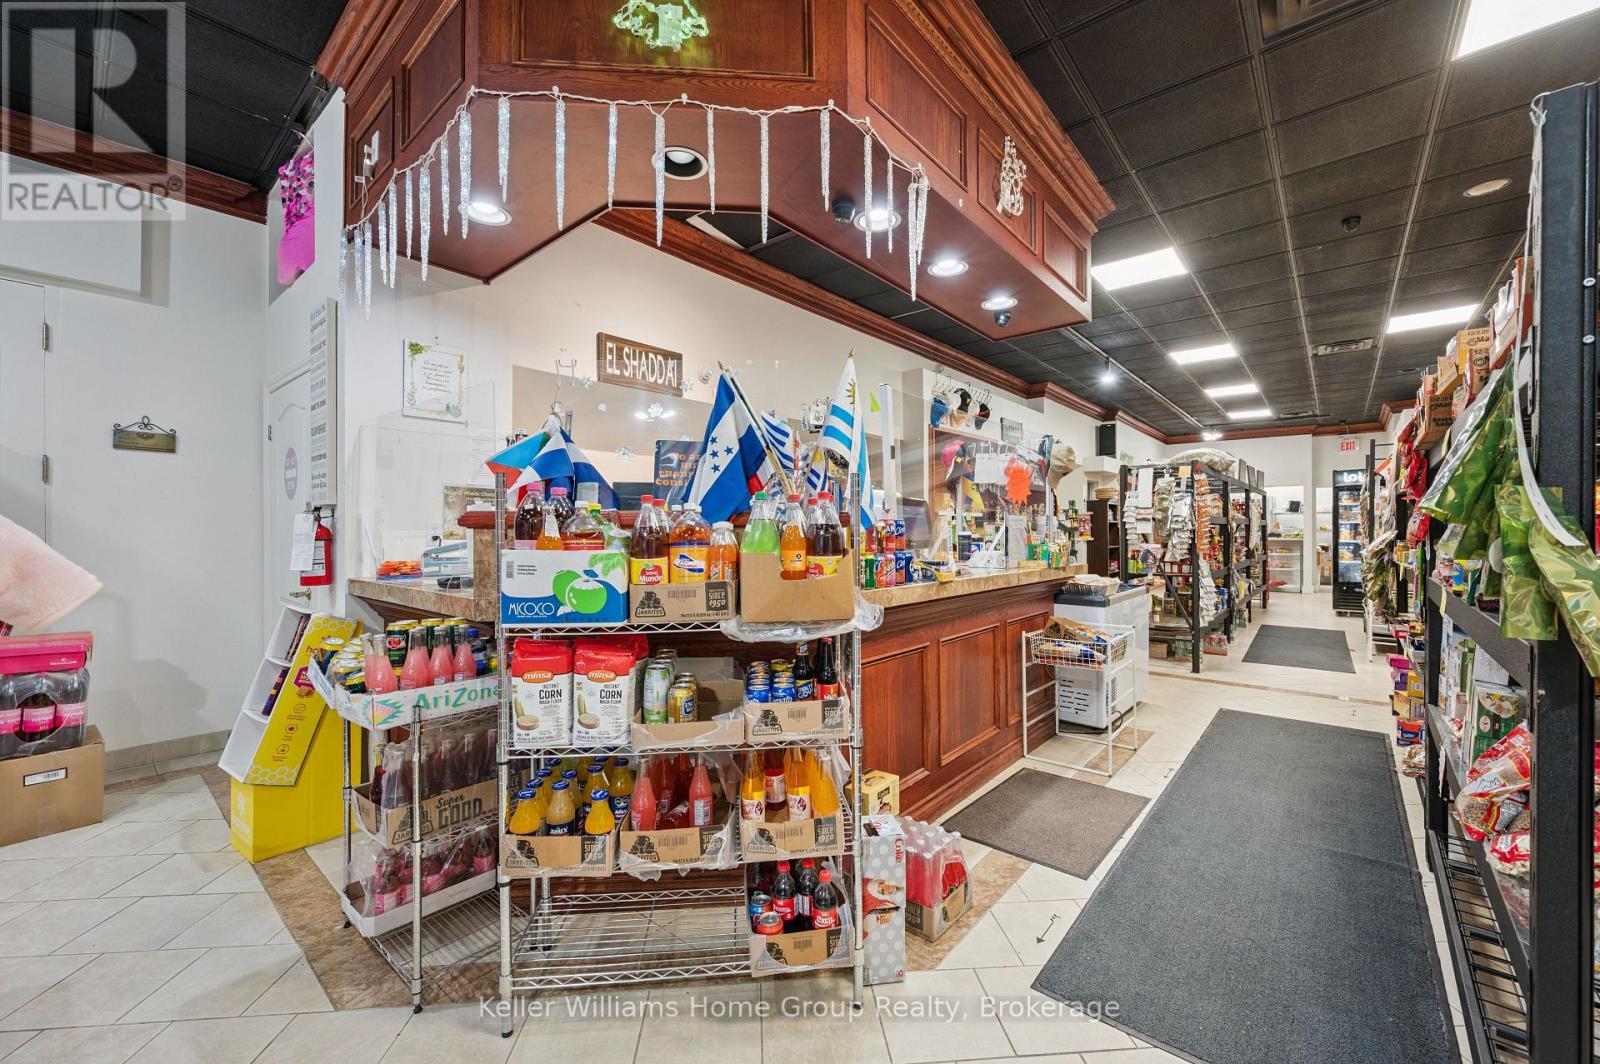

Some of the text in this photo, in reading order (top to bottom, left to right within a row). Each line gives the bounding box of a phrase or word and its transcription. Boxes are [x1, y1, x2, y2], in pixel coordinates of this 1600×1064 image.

[606, 341, 678, 389] EL SHADDAI
[1340, 441, 1356, 451] EXIT
[508, 602, 555, 616] MICOCO
[709, 599, 726, 608] 1950
[637, 608, 663, 616] JARRITOS
[523, 671, 553, 680] minsa
[588, 671, 616, 680] minsa
[539, 689, 563, 700] CORN
[600, 689, 623, 700] CORN
[436, 794, 465, 809] Super
[895, 837, 905, 863] Coke
